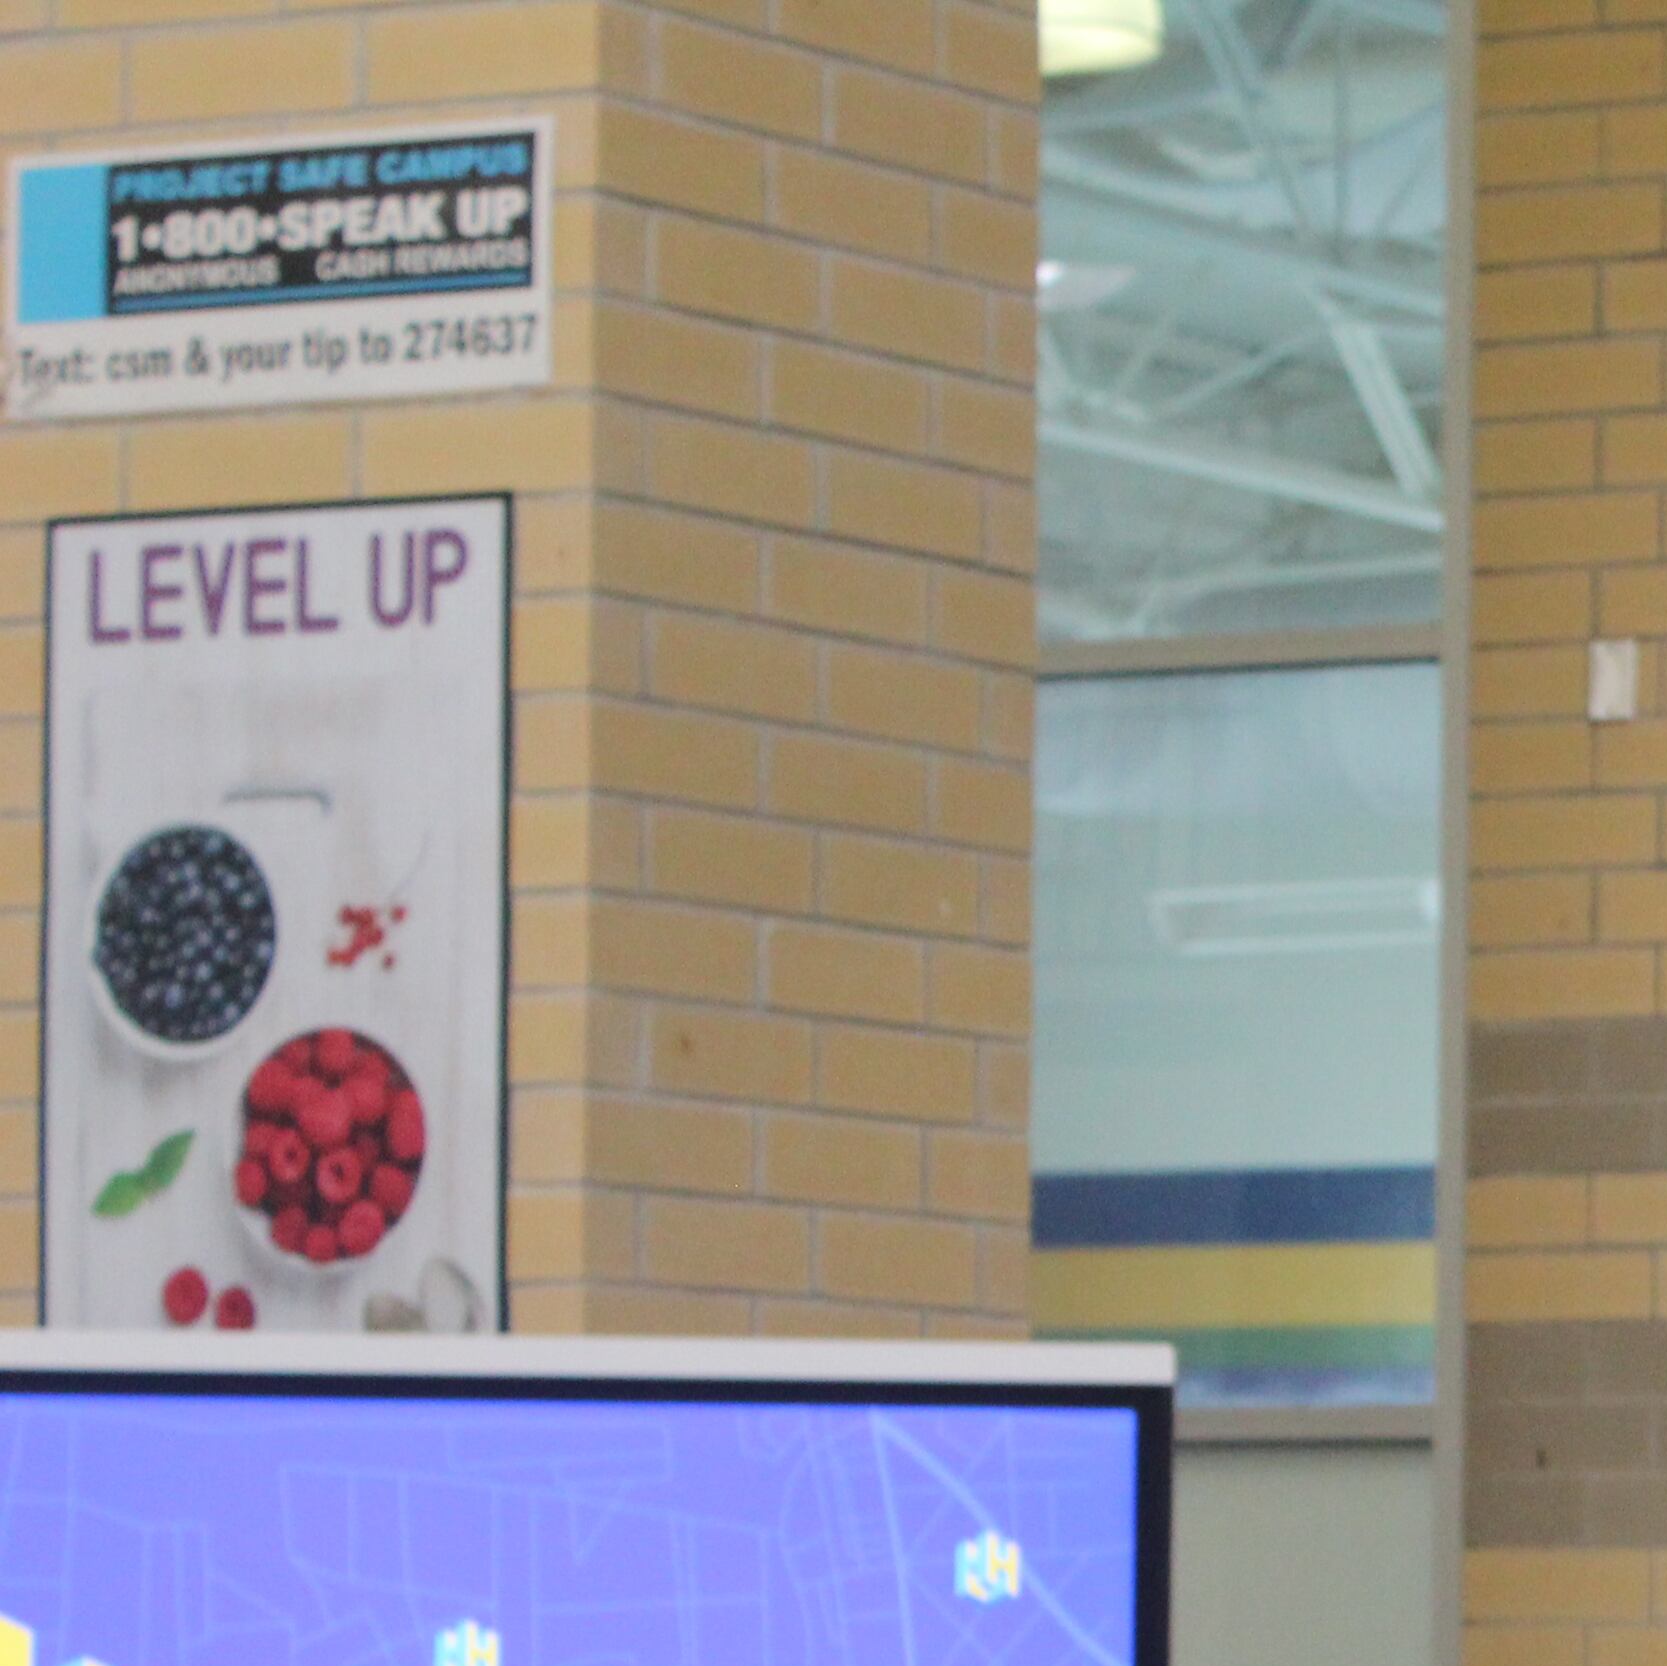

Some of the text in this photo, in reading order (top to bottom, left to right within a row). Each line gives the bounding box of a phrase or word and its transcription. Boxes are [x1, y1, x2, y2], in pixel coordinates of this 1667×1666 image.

[278, 153, 370, 191] SAFE
[376, 142, 528, 182] CAMPUS
[456, 186, 528, 237] UP
[316, 246, 393, 282] CASH
[106, 346, 172, 383] csm
[184, 337, 209, 376] &
[219, 340, 291, 383] your
[303, 327, 347, 372] tip
[359, 329, 391, 364] to
[402, 315, 539, 362] 274637
[89, 528, 469, 645] LEVEL UP
